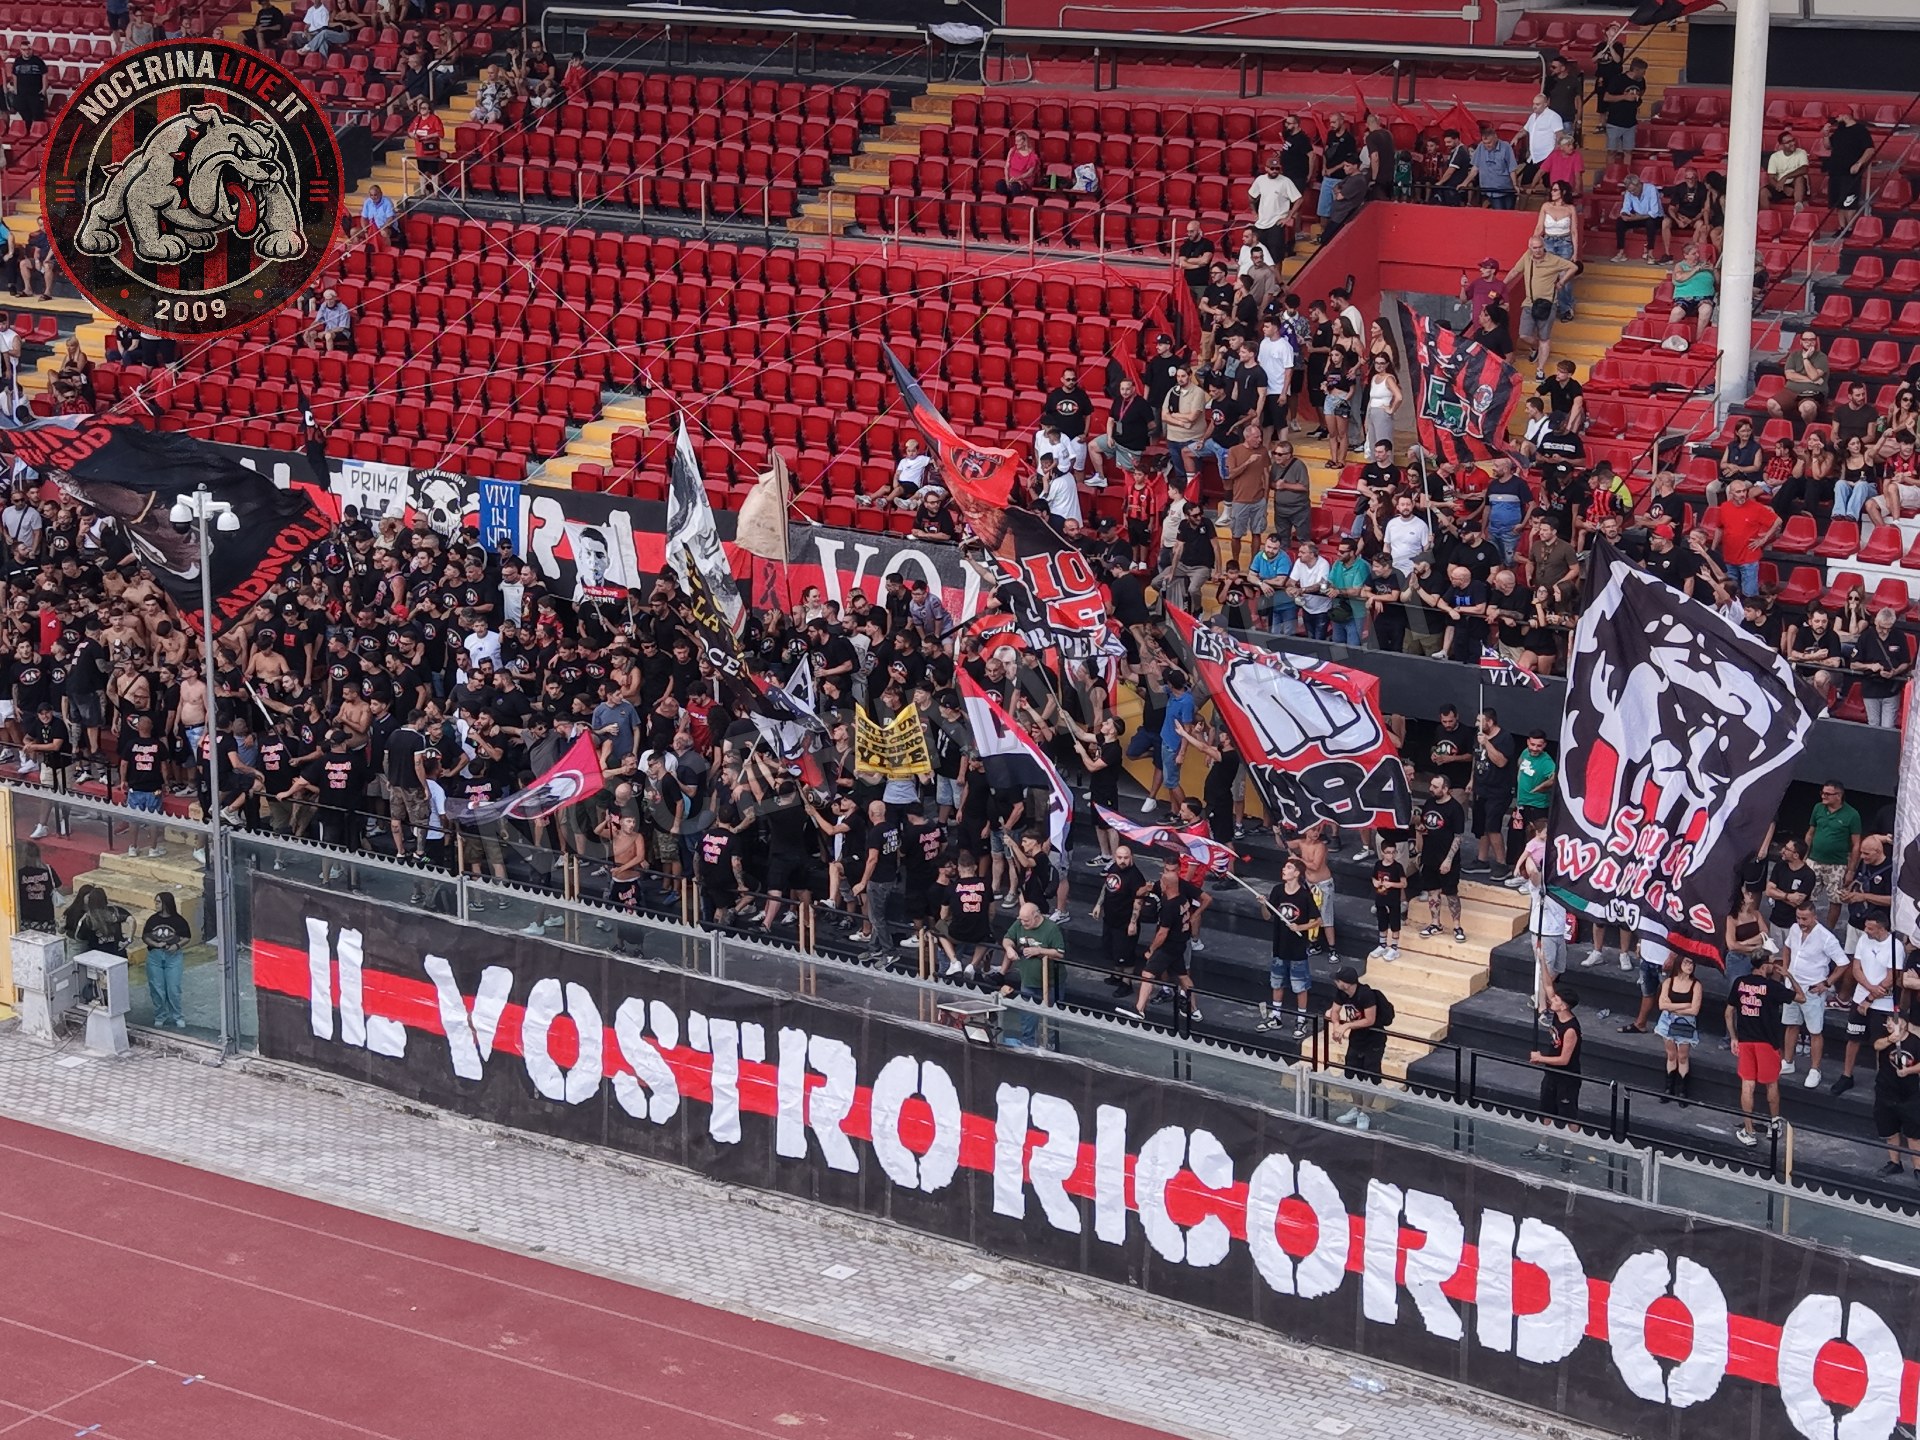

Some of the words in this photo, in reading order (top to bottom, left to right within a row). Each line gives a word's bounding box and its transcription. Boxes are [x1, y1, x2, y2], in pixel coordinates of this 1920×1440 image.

[50, 427, 112, 470] SUD
[351, 469, 399, 496] PRIMA
[485, 484, 514, 508] VIVI
[491, 507, 508, 527] IN
[898, 714, 918, 731] UN
[872, 736, 924, 754] ETERNO
[857, 745, 928, 768] VIVE
[1738, 981, 1767, 996] Angeli
[1740, 994, 1762, 1007] della
[1741, 1004, 1760, 1016] Sud
[305, 917, 405, 1058] IL
[424, 954, 962, 1194] VOSTRO
[992, 1082, 1729, 1408] RICORDO
